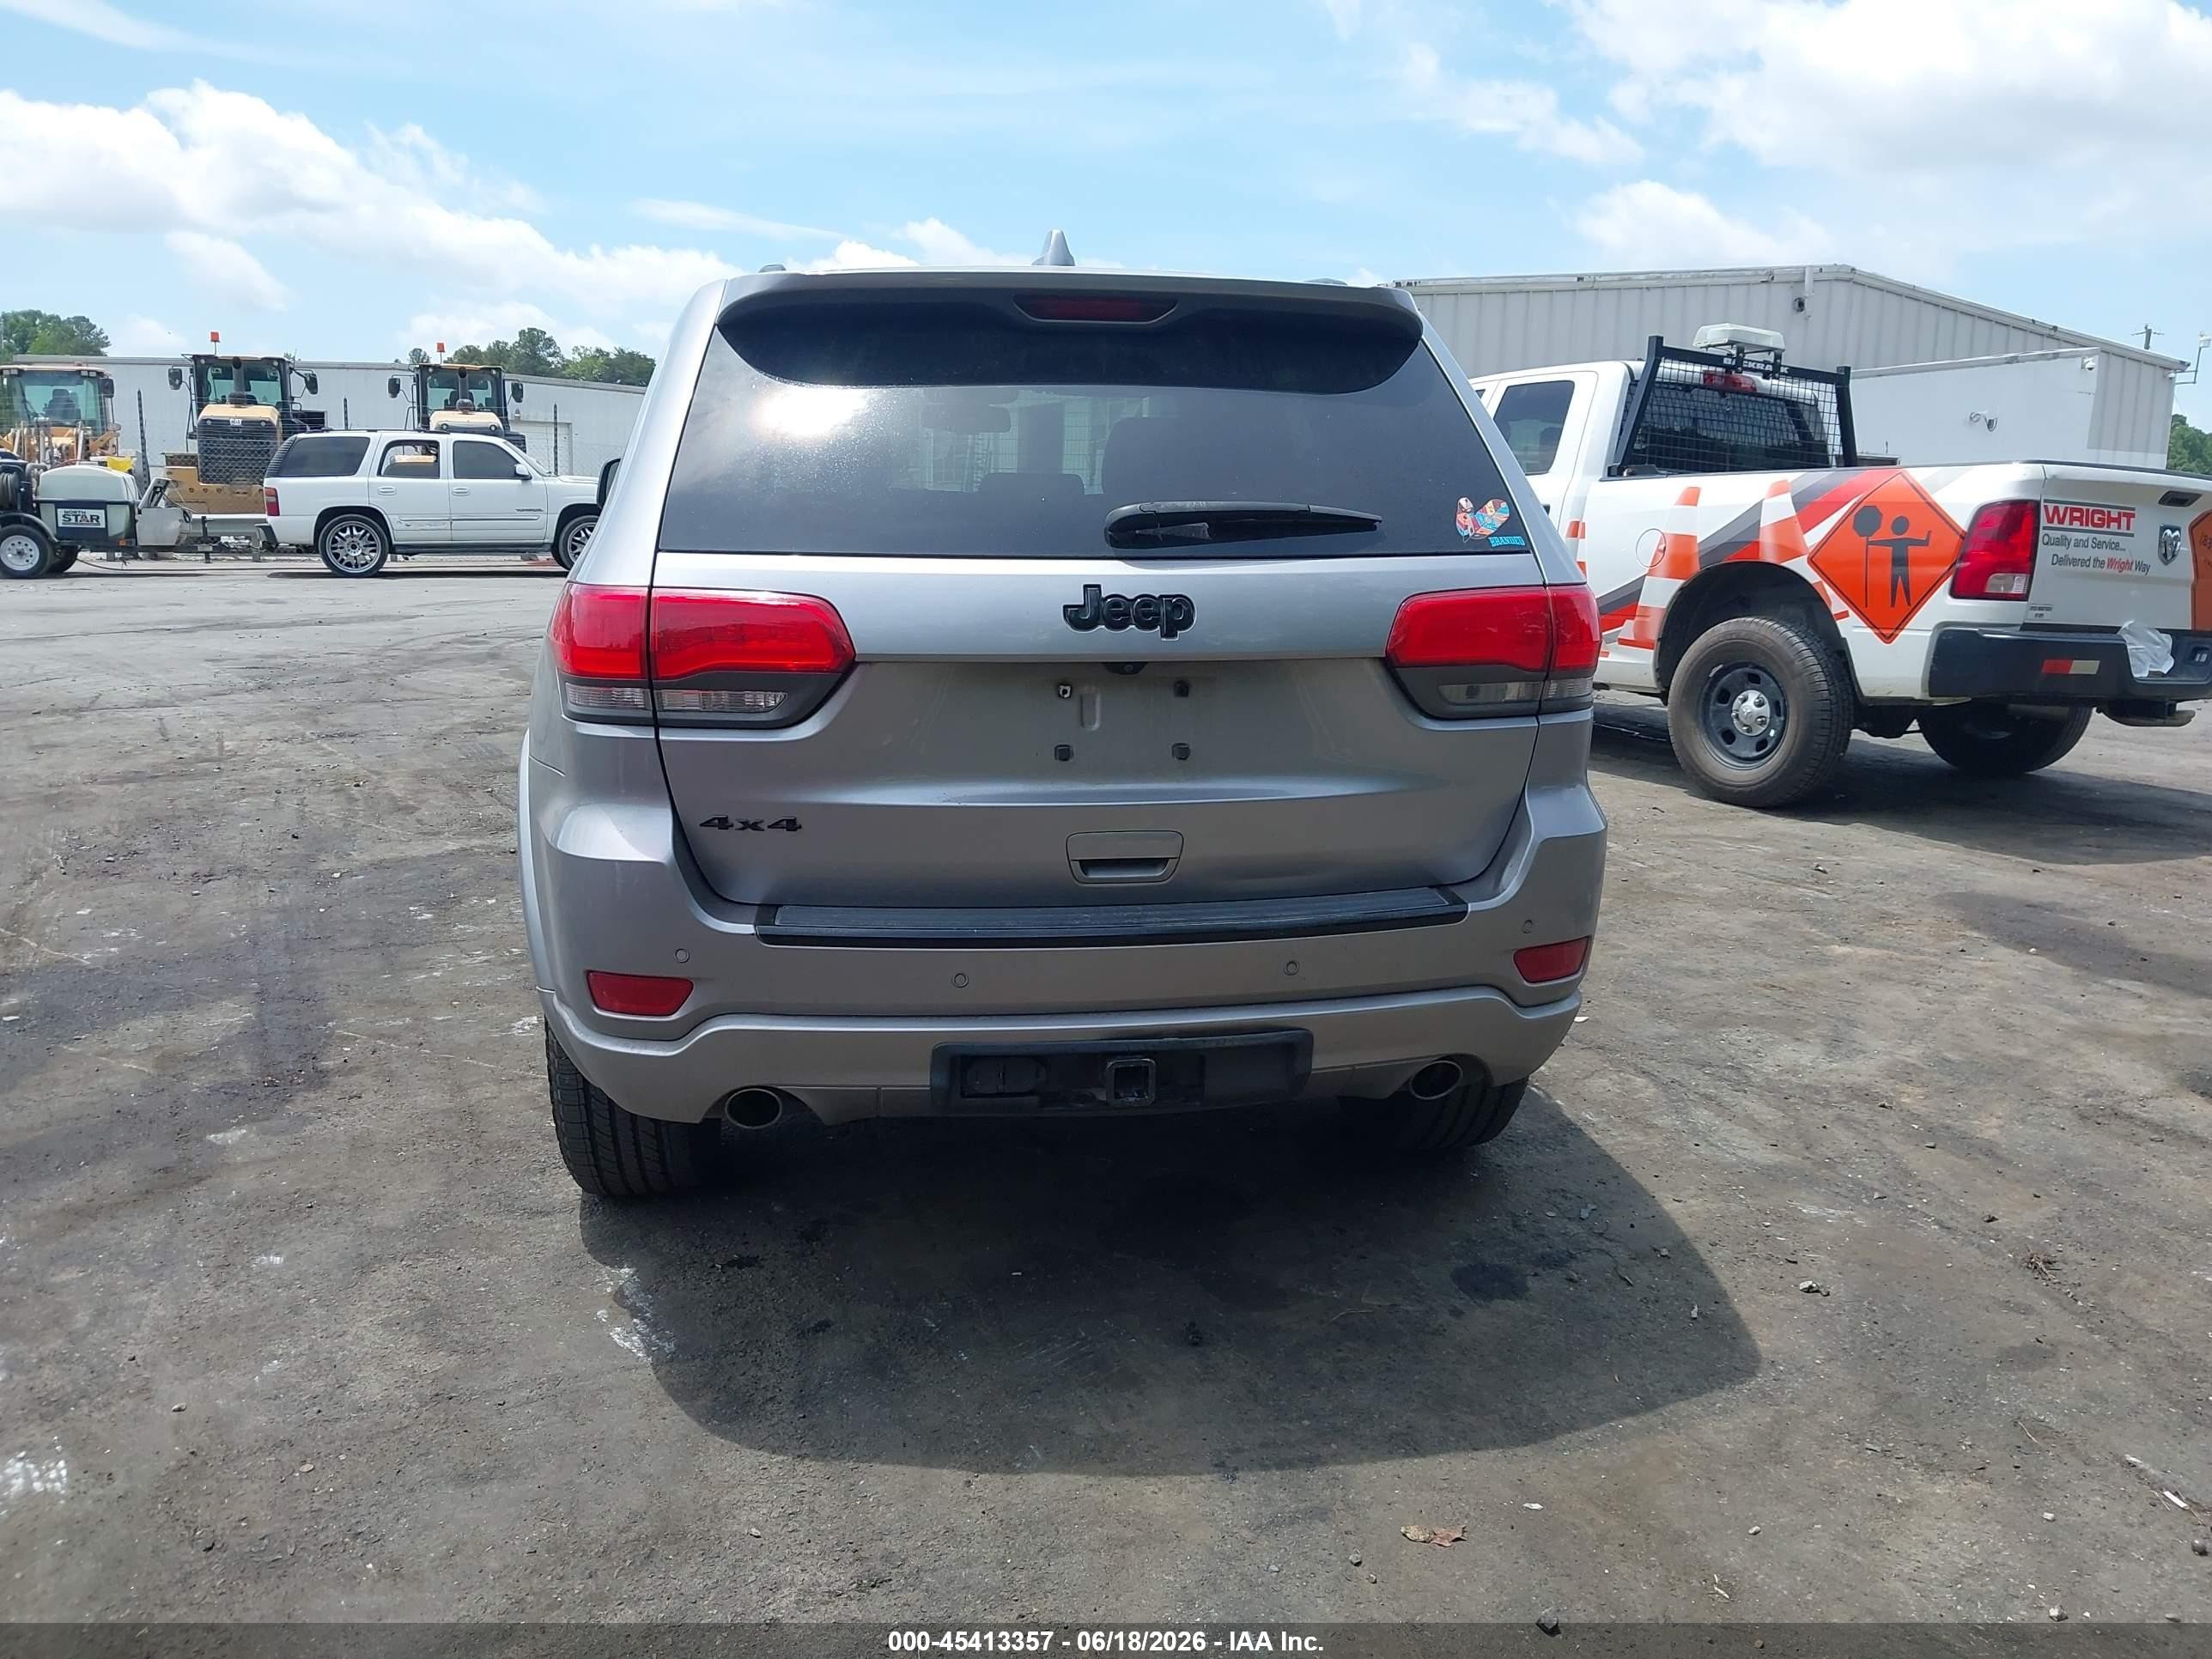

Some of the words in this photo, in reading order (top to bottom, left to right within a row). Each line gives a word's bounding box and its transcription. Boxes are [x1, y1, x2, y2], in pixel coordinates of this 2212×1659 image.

[62, 514, 100, 523] STAR
[2043, 505, 2136, 531] WRIGHT
[2042, 533, 2072, 550] Quality
[2073, 536, 2089, 549] and
[2091, 538, 2126, 551] Service...
[2051, 554, 2092, 568] Delivered
[2093, 556, 2106, 569] the
[2106, 556, 2134, 573] Wright
[2135, 560, 2151, 575] Way
[1062, 583, 1196, 641] Jeep
[699, 814, 802, 832] 4x4
